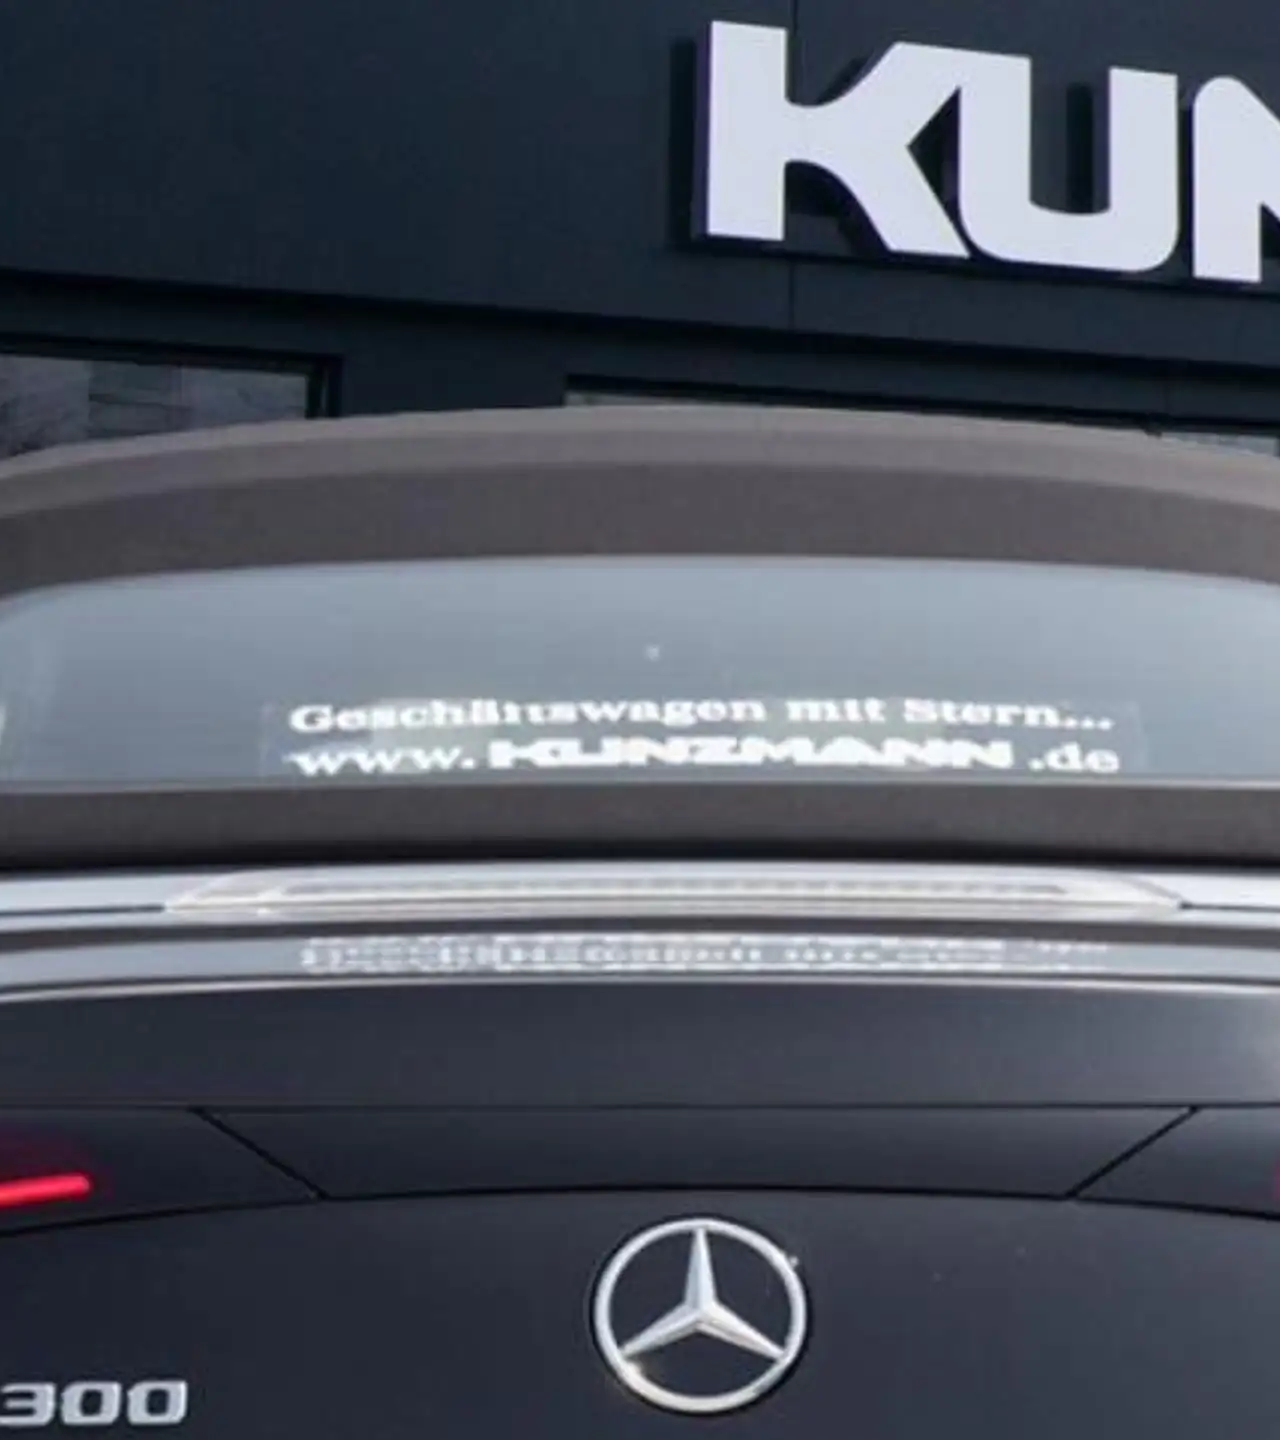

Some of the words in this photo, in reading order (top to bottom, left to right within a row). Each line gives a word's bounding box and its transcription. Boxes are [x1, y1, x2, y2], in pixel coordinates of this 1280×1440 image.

[784, 697, 888, 723] mit
[283, 744, 476, 776] www.
[487, 735, 1016, 770] KUNZMANN
